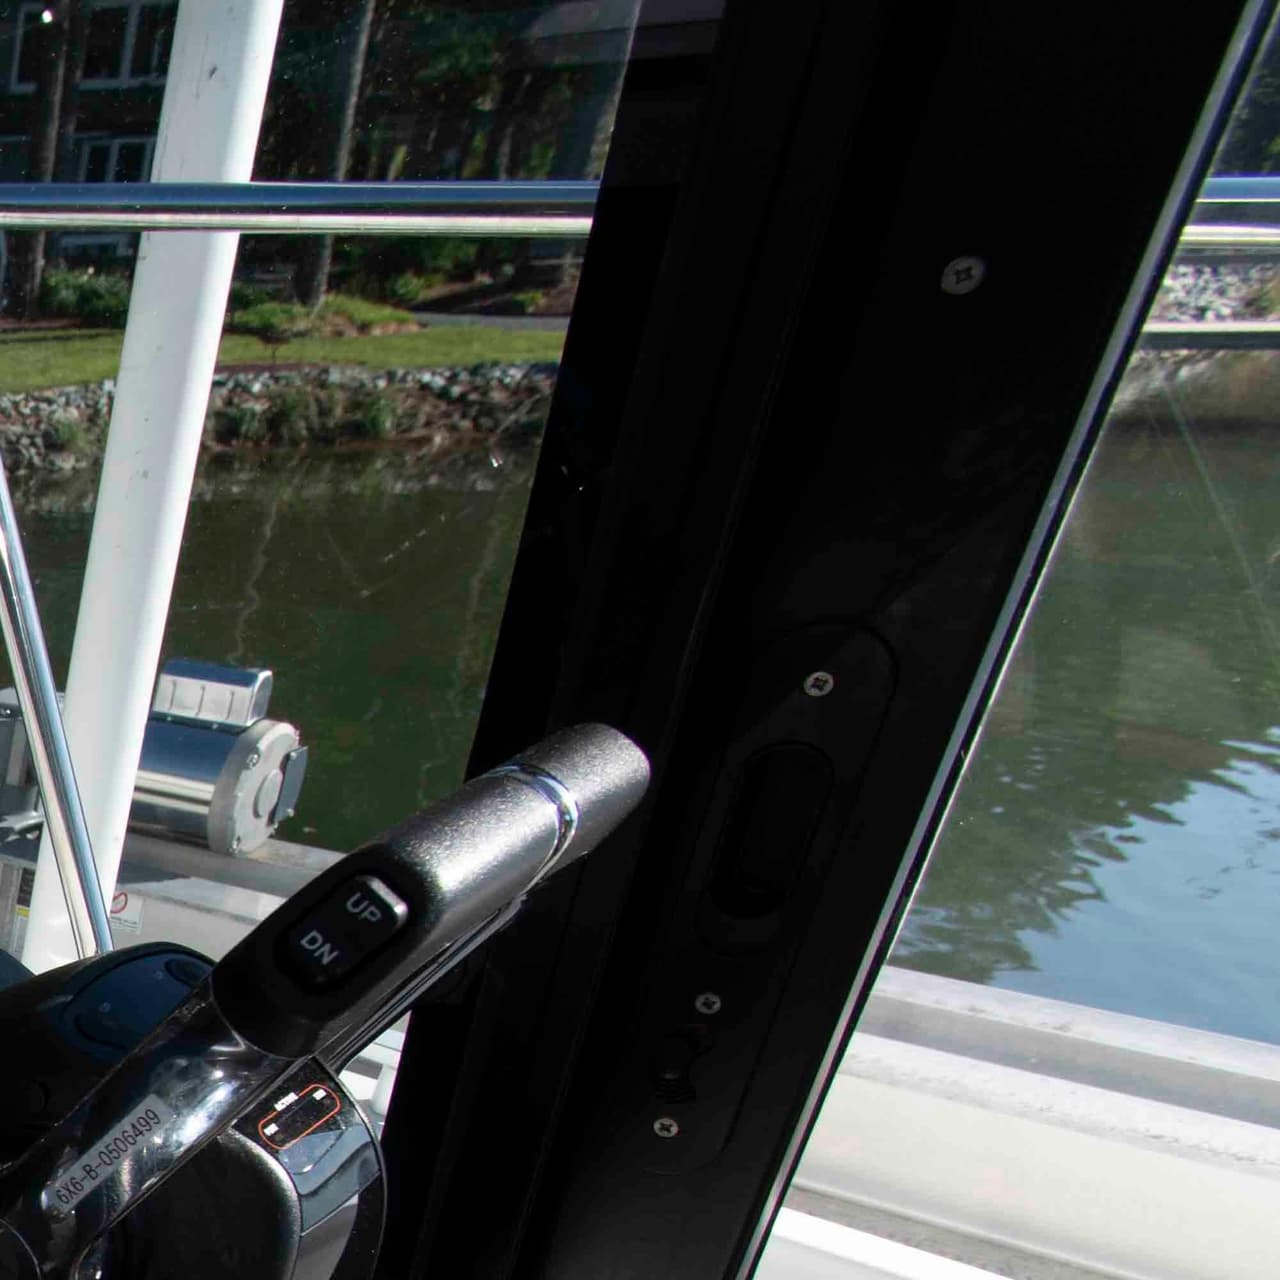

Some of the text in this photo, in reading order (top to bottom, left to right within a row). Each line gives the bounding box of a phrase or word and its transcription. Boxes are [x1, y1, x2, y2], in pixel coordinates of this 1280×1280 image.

[346, 892, 381, 922] UP
[301, 929, 339, 965] DN
[56, 1108, 161, 1205] 6X6-B-0506499
